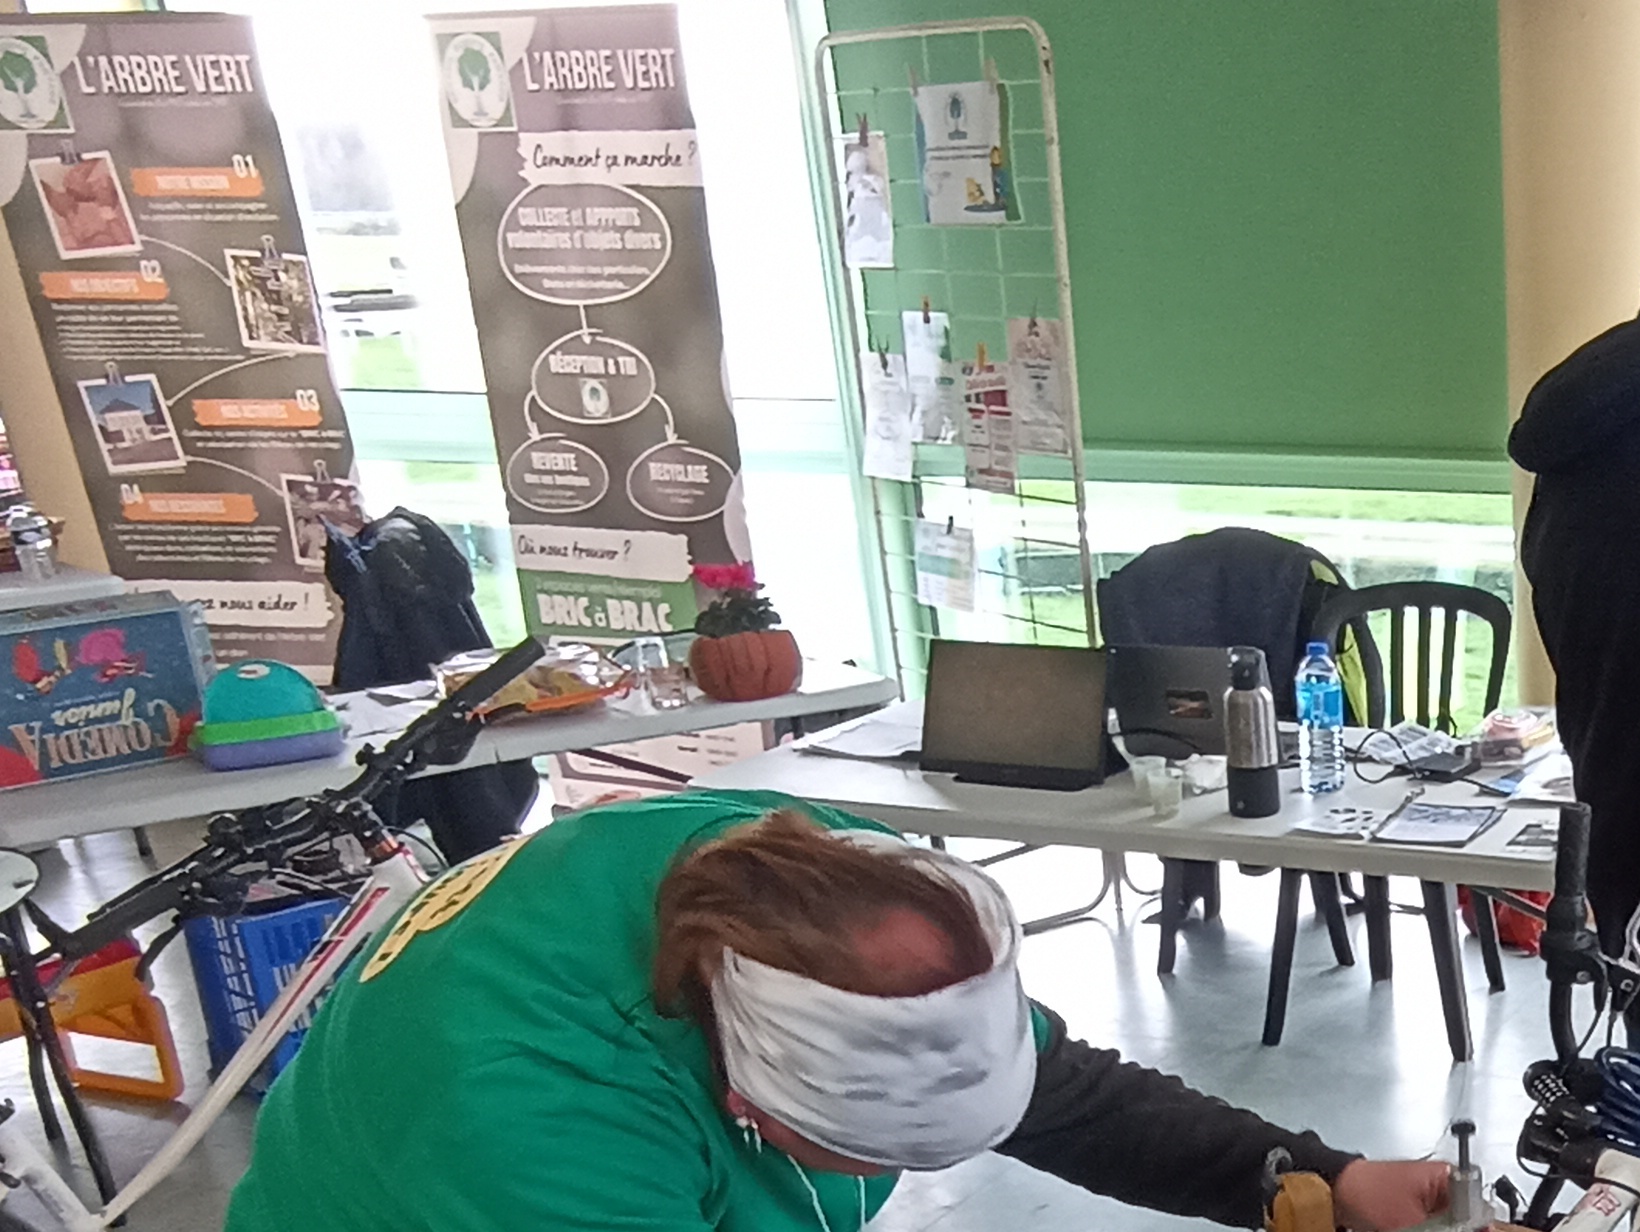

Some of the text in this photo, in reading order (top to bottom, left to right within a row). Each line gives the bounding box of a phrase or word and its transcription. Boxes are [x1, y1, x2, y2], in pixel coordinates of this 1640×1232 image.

[73, 54, 255, 94] L'ARBRE VERT
[522, 48, 677, 92] L'ARBRE VERT
[232, 154, 258, 179] 01
[533, 140, 697, 174] Comment ça marche ?
[140, 259, 165, 283] 02
[295, 389, 320, 412] 03
[517, 534, 538, 556] Où
[539, 545, 569, 557] nous
[623, 539, 633, 561] ?
[219, 598, 254, 611] nous
[257, 593, 298, 611] aider
[537, 593, 674, 633] BRIC à BRAC
[52, 687, 136, 727] Junior
[8, 697, 181, 772] COMEDIA
